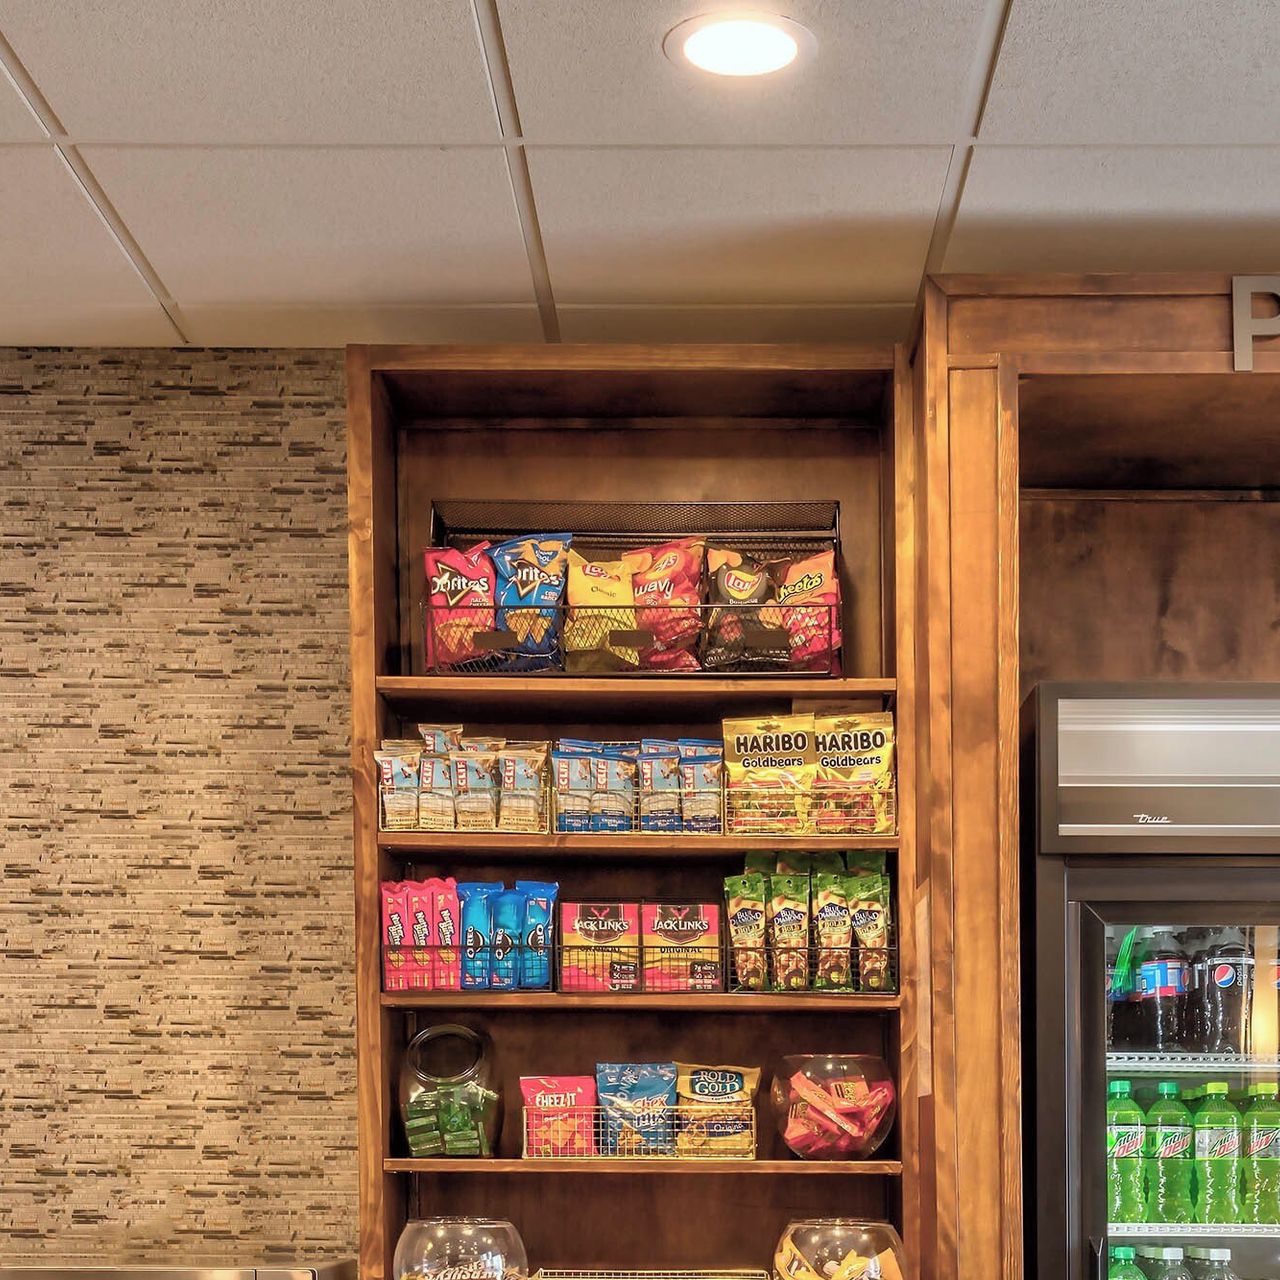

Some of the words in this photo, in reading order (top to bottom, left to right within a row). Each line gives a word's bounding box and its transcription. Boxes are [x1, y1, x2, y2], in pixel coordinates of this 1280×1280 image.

[431, 574, 489, 594] Doritos
[517, 568, 559, 585] ritos
[735, 732, 808, 754] HARIBO
[816, 731, 885, 752] HARIBO
[505, 759, 515, 782] CLIF
[742, 756, 803, 768] Goldbears
[821, 755, 881, 767] Goldbears
[457, 761, 467, 786] CLIF
[559, 760, 569, 785] CLIF
[597, 761, 607, 785] CLIF
[643, 761, 653, 786] CLIF
[572, 919, 598, 931] JACK
[599, 920, 629, 931] LINK'S
[652, 920, 678, 931] JACK
[679, 920, 709, 931] LINK'S
[536, 924, 544, 955] ORO
[699, 1071, 736, 1082] ROLD
[695, 1082, 739, 1095] GOLD
